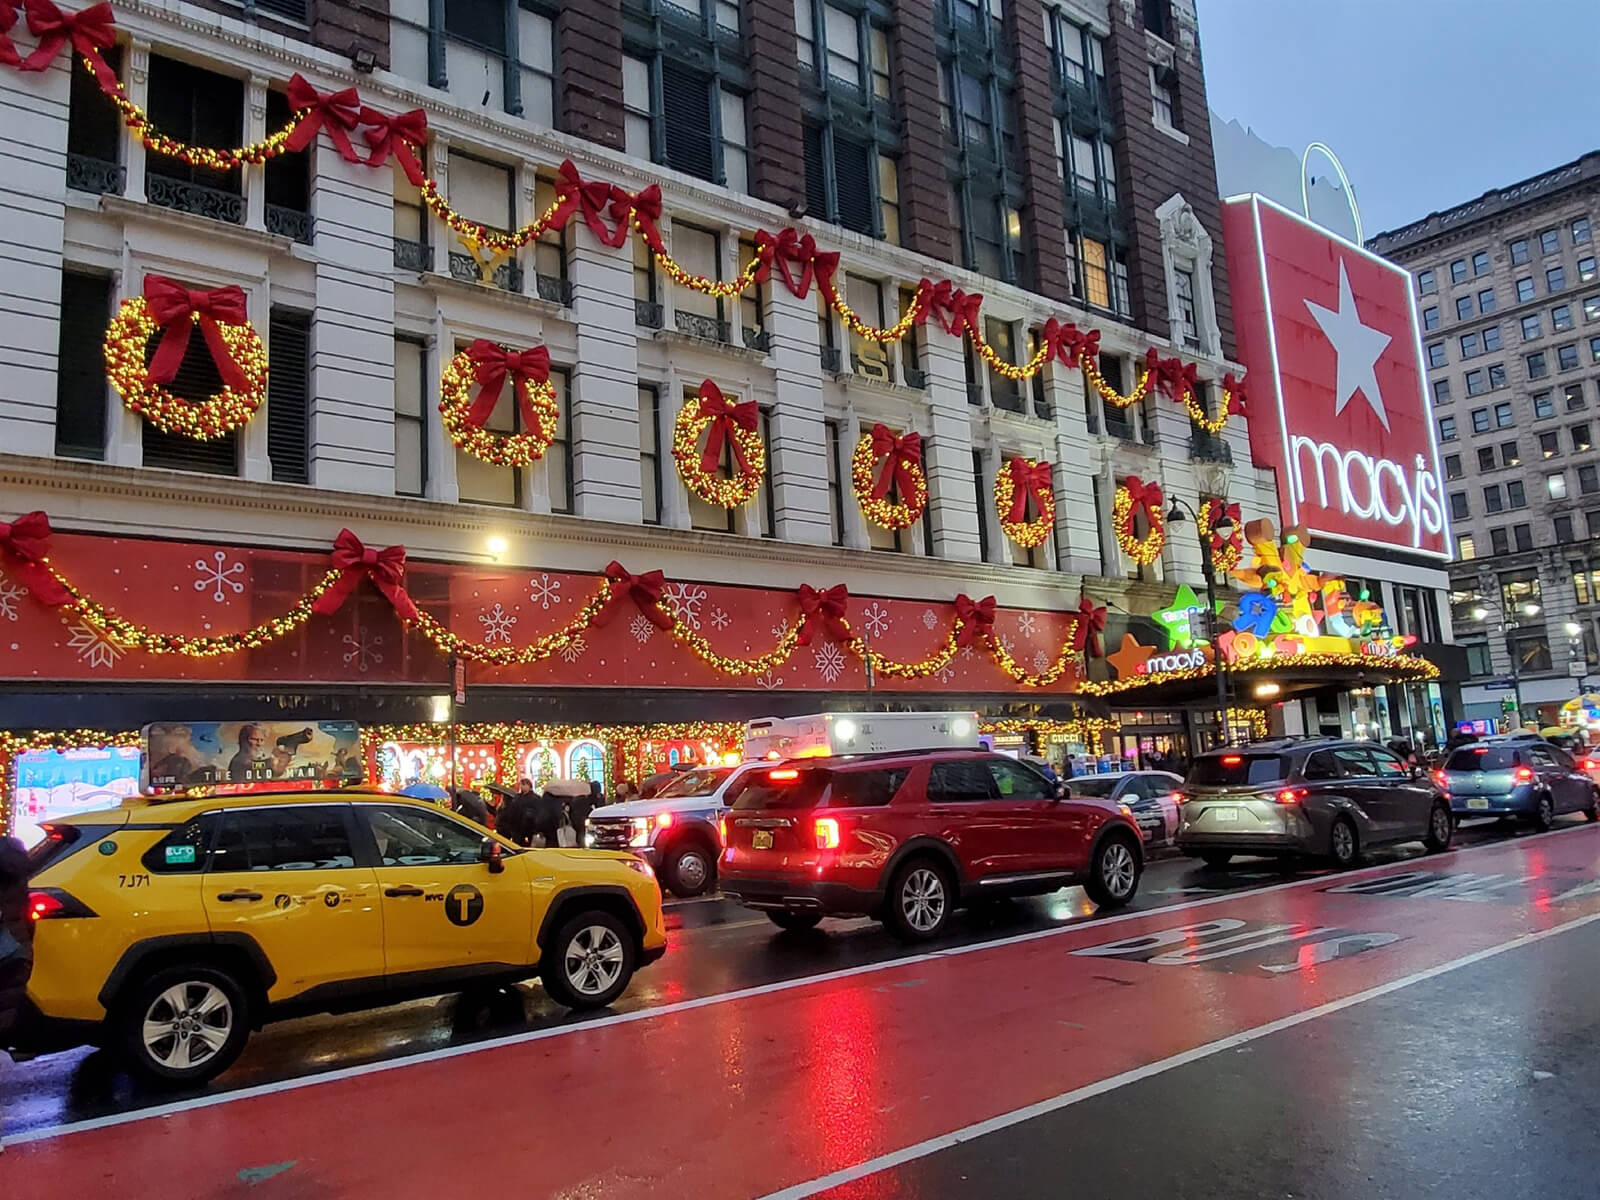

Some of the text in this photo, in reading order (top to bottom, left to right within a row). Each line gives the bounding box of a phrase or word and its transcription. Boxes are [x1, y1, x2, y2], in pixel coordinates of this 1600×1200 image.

[1052, 733, 1080, 743] GUCCI
[204, 767, 316, 781] THE OLD MAN
[119, 875, 150, 888] 7J71
[425, 892, 475, 921] NYC T
